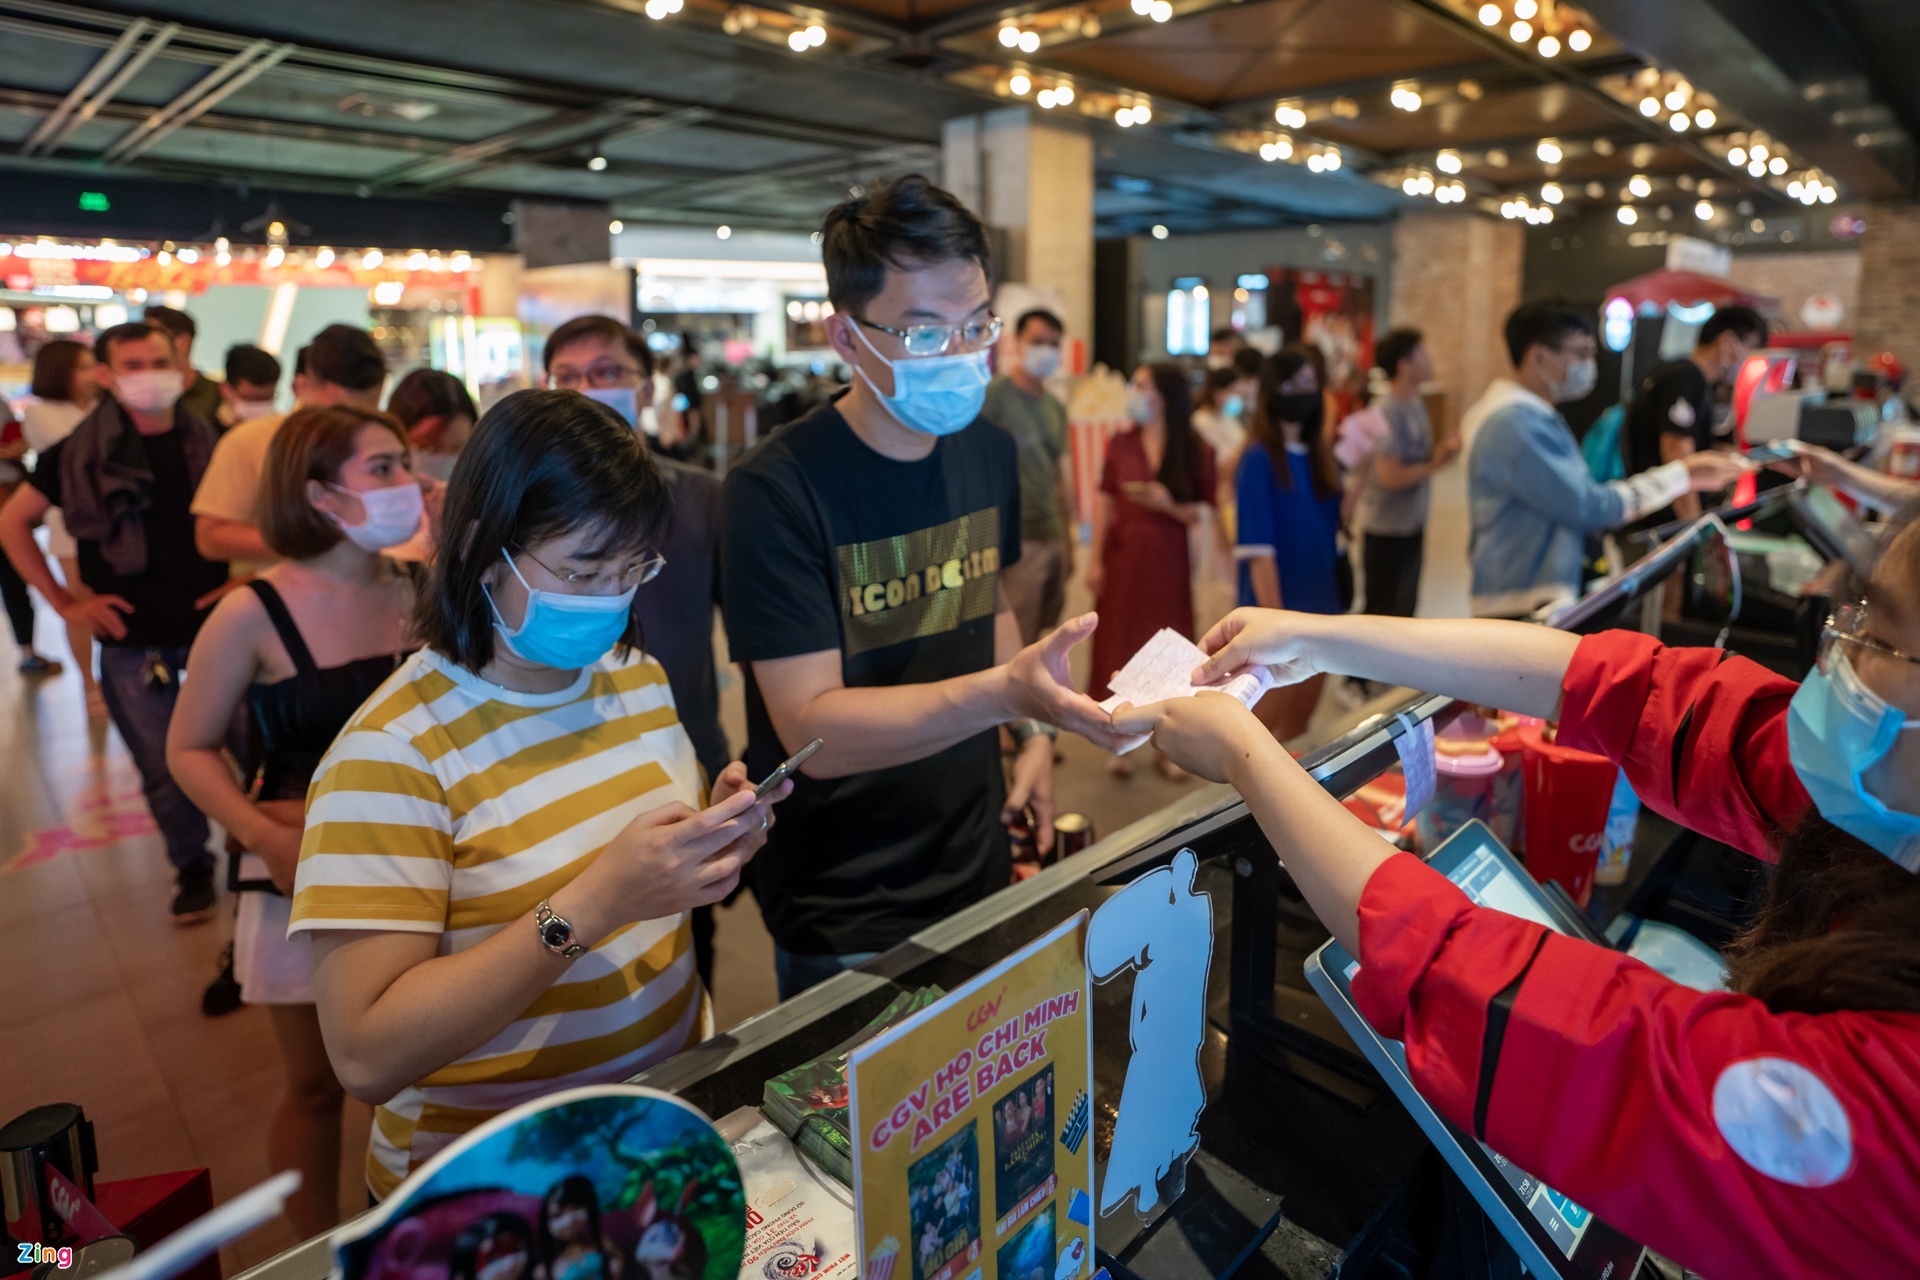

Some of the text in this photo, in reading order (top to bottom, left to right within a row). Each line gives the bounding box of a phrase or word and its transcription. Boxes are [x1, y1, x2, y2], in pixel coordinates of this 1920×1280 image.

[967, 995, 1002, 1032] CGV
[871, 990, 1079, 1150] CGV HO CHI MINH
[911, 1030, 1047, 1153] ARE BACK
[766, 1228, 777, 1236] 31
[747, 1255, 759, 1264] 90
[823, 1262, 838, 1274] PHIM
